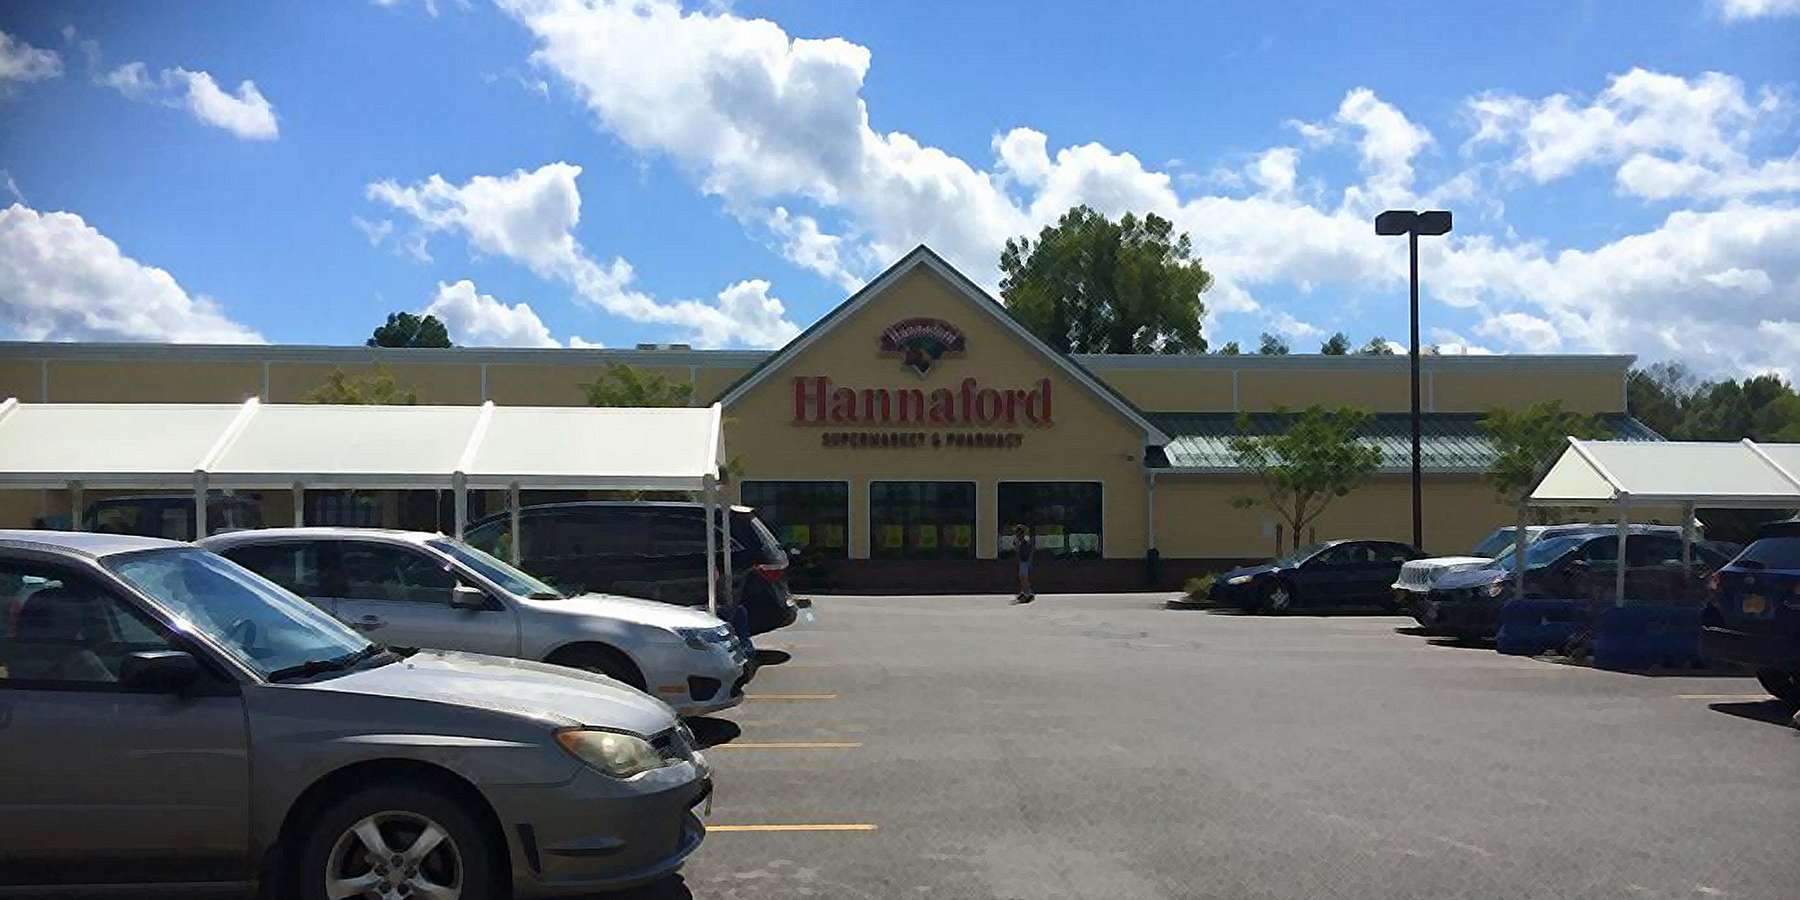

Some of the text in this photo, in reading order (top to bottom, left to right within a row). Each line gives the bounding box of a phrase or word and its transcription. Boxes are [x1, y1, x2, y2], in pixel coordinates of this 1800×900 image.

[792, 376, 1053, 426] Hannaford
[822, 432, 1024, 449] SUPERMARKET & PHARMACY
